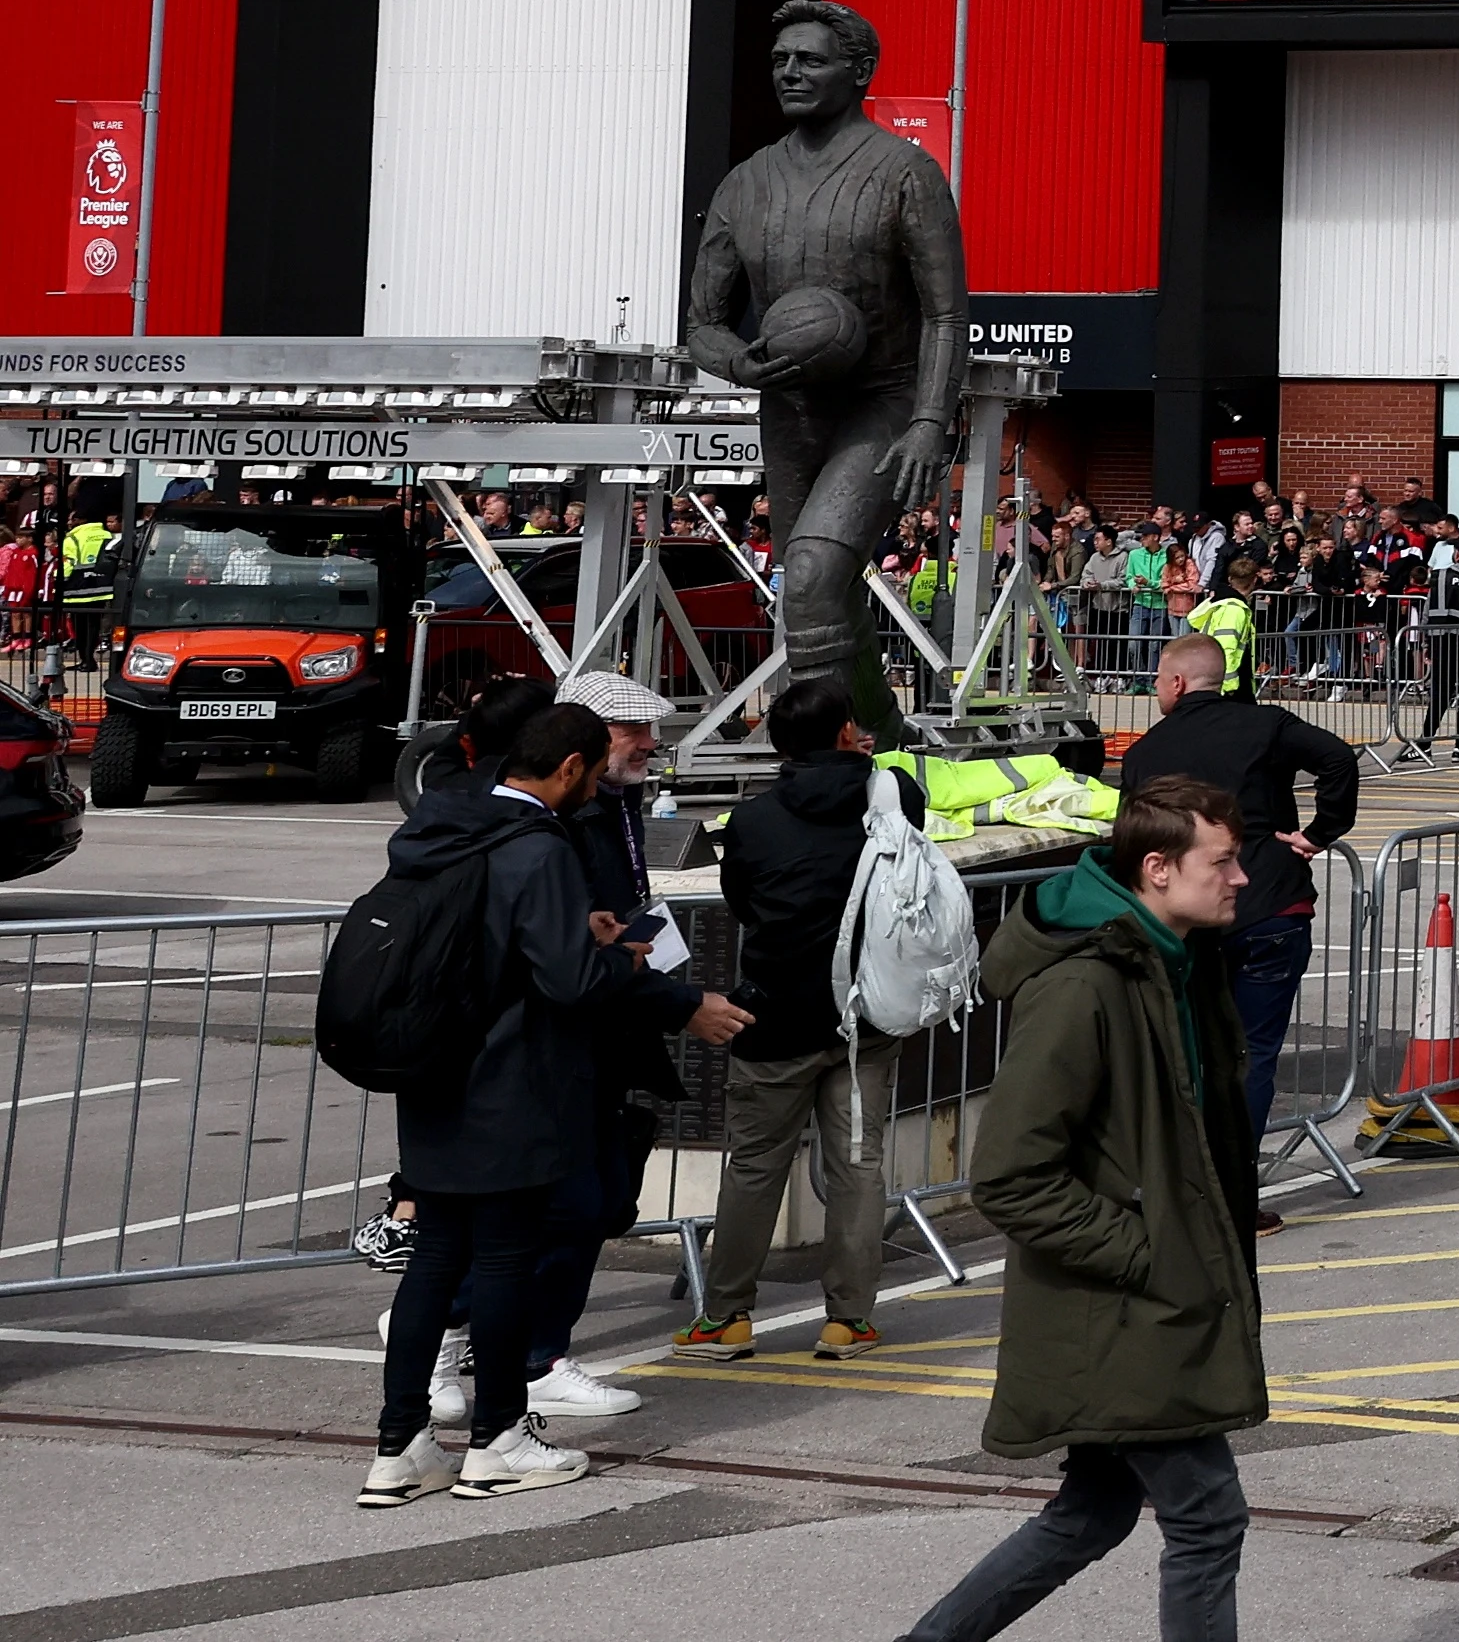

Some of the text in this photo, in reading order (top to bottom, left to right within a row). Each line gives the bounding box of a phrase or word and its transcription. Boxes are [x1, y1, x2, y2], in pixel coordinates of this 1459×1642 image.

[92, 121, 124, 130] WE ARE
[893, 118, 928, 127] WE ARE
[80, 197, 130, 212] Premier
[79, 211, 129, 229] League
[990, 323, 1073, 343] UNITED
[49, 354, 88, 373] FOR
[94, 354, 186, 373] SUCCESS
[27, 427, 410, 458] TURF LIGHTING SOLUTIONS
[1218, 447, 1236, 456] TICKET
[187, 703, 269, 717] BD69 EPL
